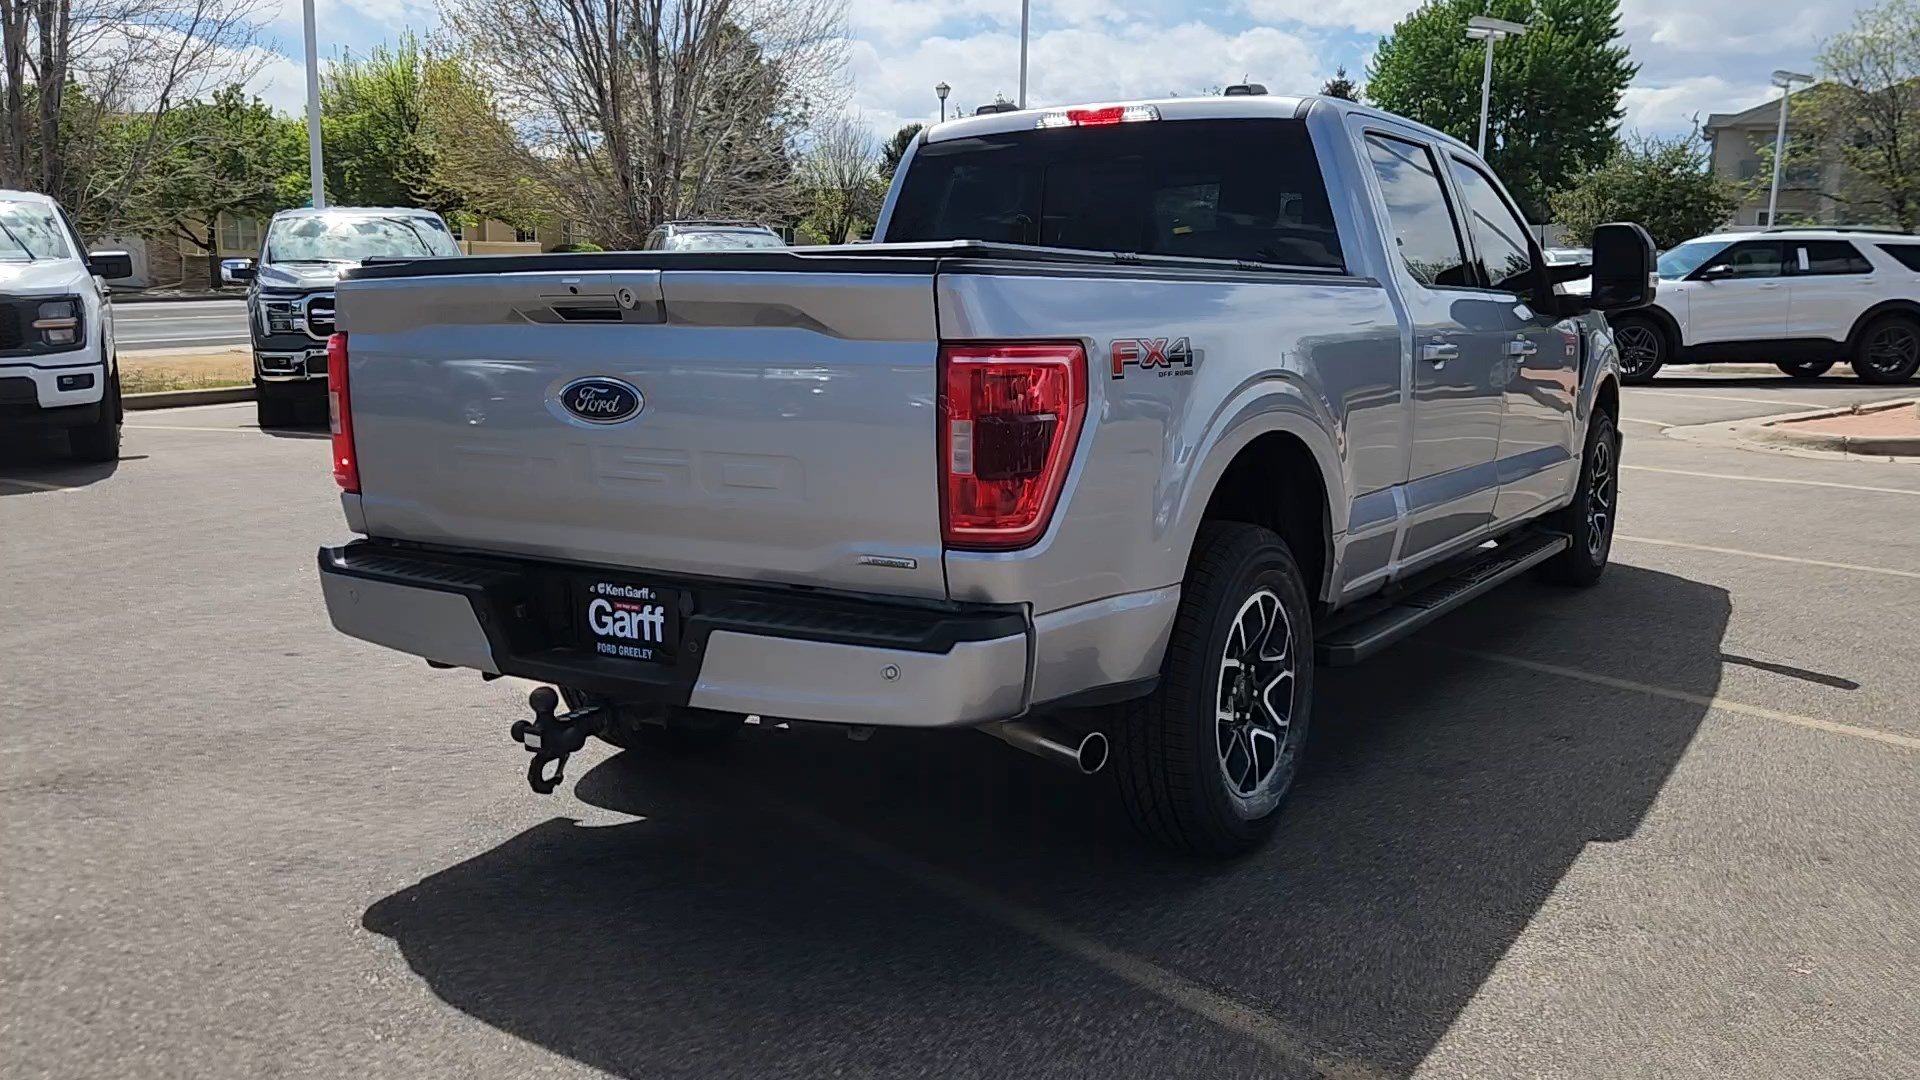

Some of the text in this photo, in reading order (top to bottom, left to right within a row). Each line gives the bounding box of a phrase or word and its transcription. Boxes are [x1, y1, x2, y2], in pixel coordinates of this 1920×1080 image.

[1109, 337, 1193, 380] FX4
[1158, 369, 1194, 378] OFF ROAD
[575, 386, 621, 413] Ford
[606, 583, 649, 599] Ken Garff
[588, 598, 665, 642] Garff
[597, 642, 653, 660] FORD GREELEY
